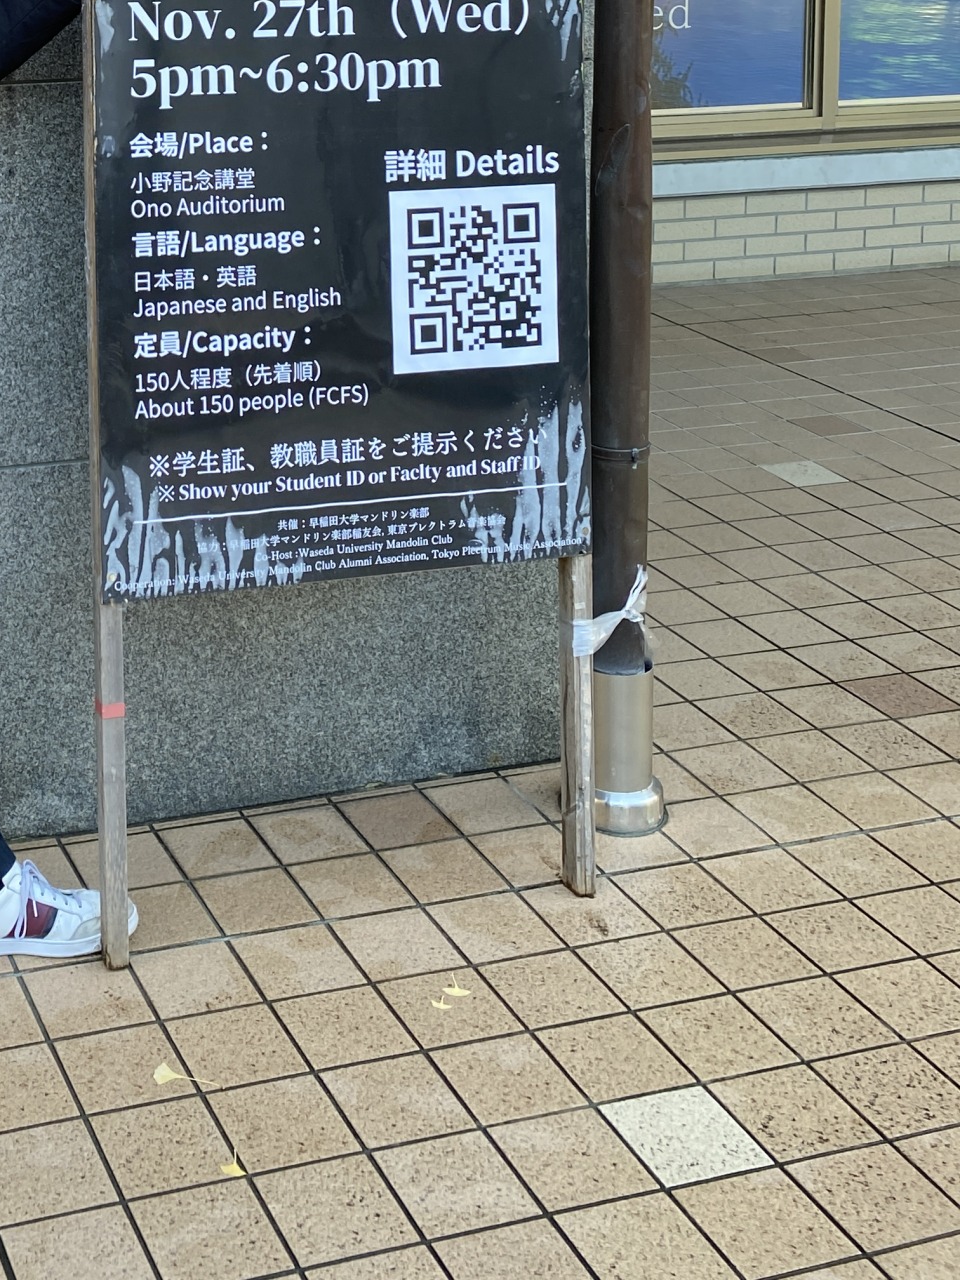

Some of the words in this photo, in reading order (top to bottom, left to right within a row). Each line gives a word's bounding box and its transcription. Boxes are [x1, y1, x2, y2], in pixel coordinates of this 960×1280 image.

[127, 1, 236, 42] Nov.
[130, 168, 256, 194] 小野記念講堂
[384, 149, 447, 183] 詳細
[455, 145, 560, 179] Details
[130, 199, 173, 219] Ono
[176, 194, 285, 217] Auditorium
[134, 265, 257, 292] 日本語・英語
[133, 294, 227, 320] Japanese
[231, 291, 268, 312] and
[272, 287, 342, 316] English
[134, 397, 195, 420] About
[199, 394, 233, 416] 150
[239, 390, 304, 417] people
[308, 383, 370, 411] (FCFS)
[179, 482, 228, 502] Show
[231, 482, 272, 502] your
[275, 474, 342, 497] Student
[346, 471, 365, 489] ID
[368, 473, 387, 487] or
[390, 463, 442, 483] Faclty
[446, 459, 477, 478] and
[481, 455, 522, 475] Staff
[522, 455, 541, 471] ID
[114, 575, 176, 592] Cooperation:
[178, 572, 216, 586] Waseda
[218, 568, 264, 583] University
[268, 562, 312, 577] Mandolin
[315, 560, 336, 572] Club
[339, 557, 372, 569] Alumni
[375, 552, 430, 566] Association,
[433, 547, 460, 561] Tokyo
[462, 543, 502, 557] Plectrum
[504, 541, 530, 553] Music
[533, 536, 583, 550] Association
[254, 551, 293, 563] Co-Host
[337, 542, 383, 556] University
[386, 537, 429, 550] Mandolin
[431, 534, 453, 545] Club
